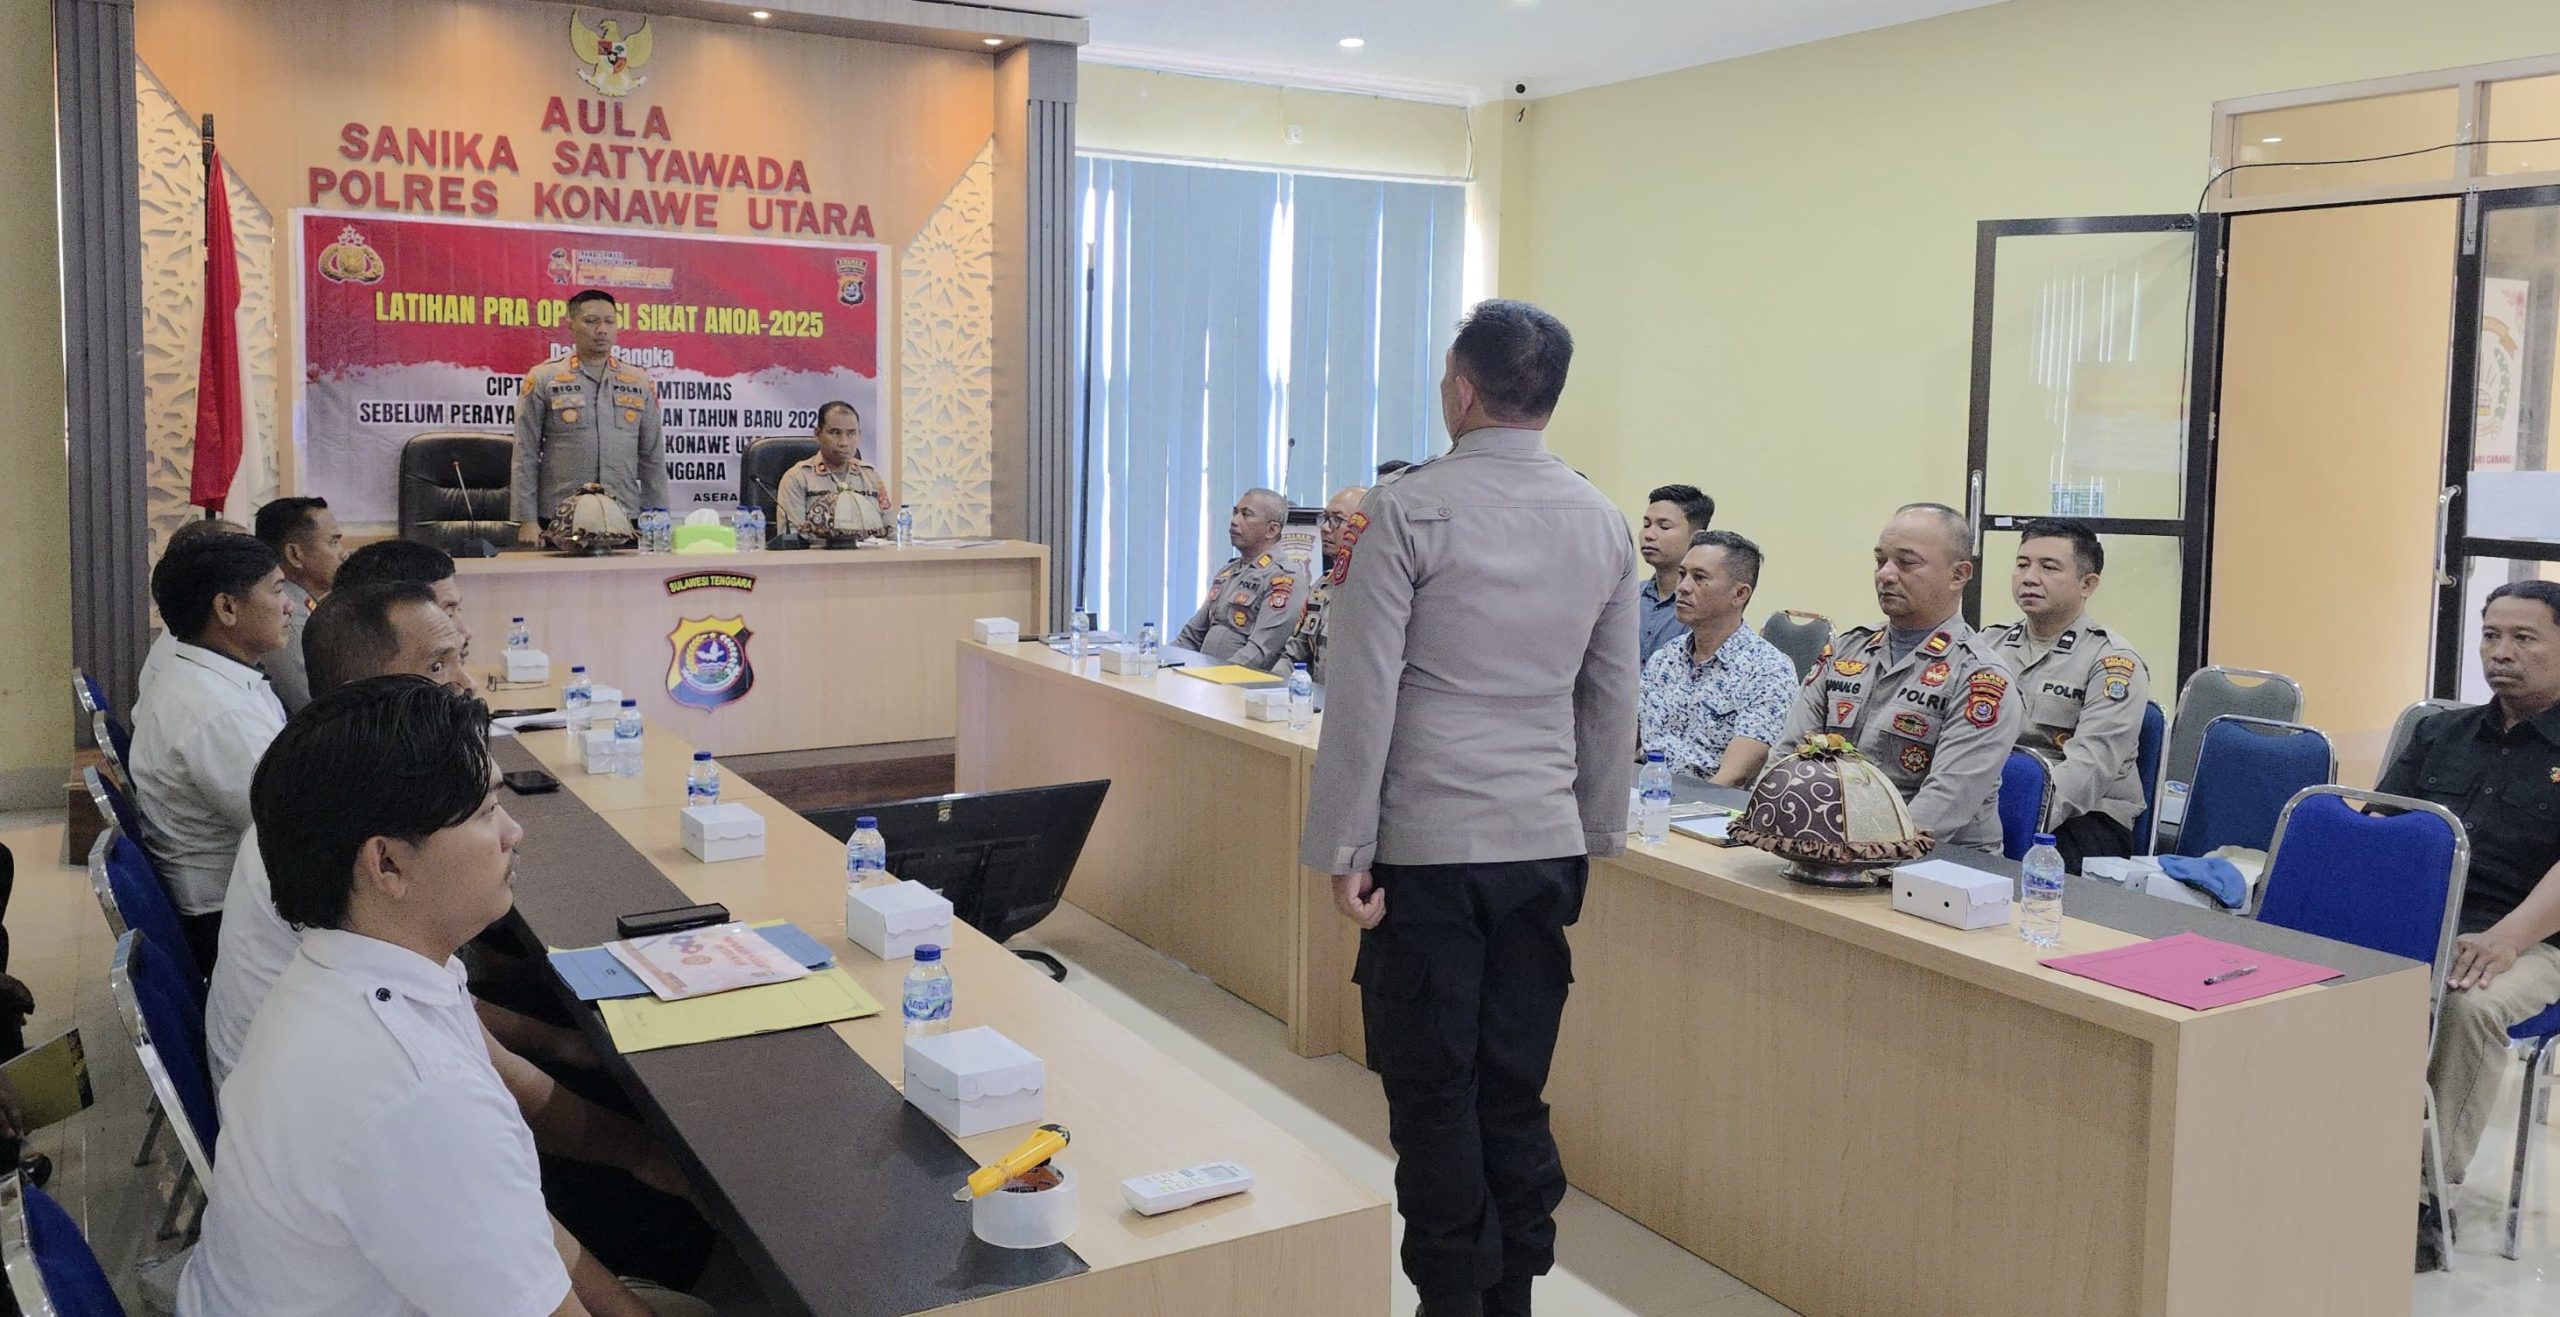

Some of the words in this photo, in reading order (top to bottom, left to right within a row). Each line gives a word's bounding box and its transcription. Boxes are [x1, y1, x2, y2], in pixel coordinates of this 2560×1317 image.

[541, 96, 671, 140] AULA
[338, 122, 519, 174] SANIKA
[552, 141, 812, 193] SATYAWADA
[308, 167, 499, 215] POLRES
[533, 182, 719, 228] KONAWE
[747, 197, 876, 237] UTARA
[375, 291, 476, 325] LATIHAN
[483, 296, 530, 327] PRA
[636, 303, 698, 333] SIKAT
[703, 306, 824, 338] ANOA-2025
[486, 376, 523, 397] CIPT
[656, 381, 732, 401] MTIBMAS
[359, 402, 444, 424] SEBELUM
[450, 404, 515, 425] PERAYA
[662, 407, 683, 427] AN
[689, 408, 738, 428] TAHUN
[744, 409, 783, 428] BARU
[788, 410, 819, 429] 202
[665, 435, 730, 454] KONAWE
[665, 462, 727, 481] NGGARA
[693, 492, 738, 502] ASERA
[669, 577, 709, 593] SULAWESI
[710, 575, 753, 589] TENGGARA
[1897, 687, 1950, 711] POLRI
[2042, 682, 2085, 700] POLR
